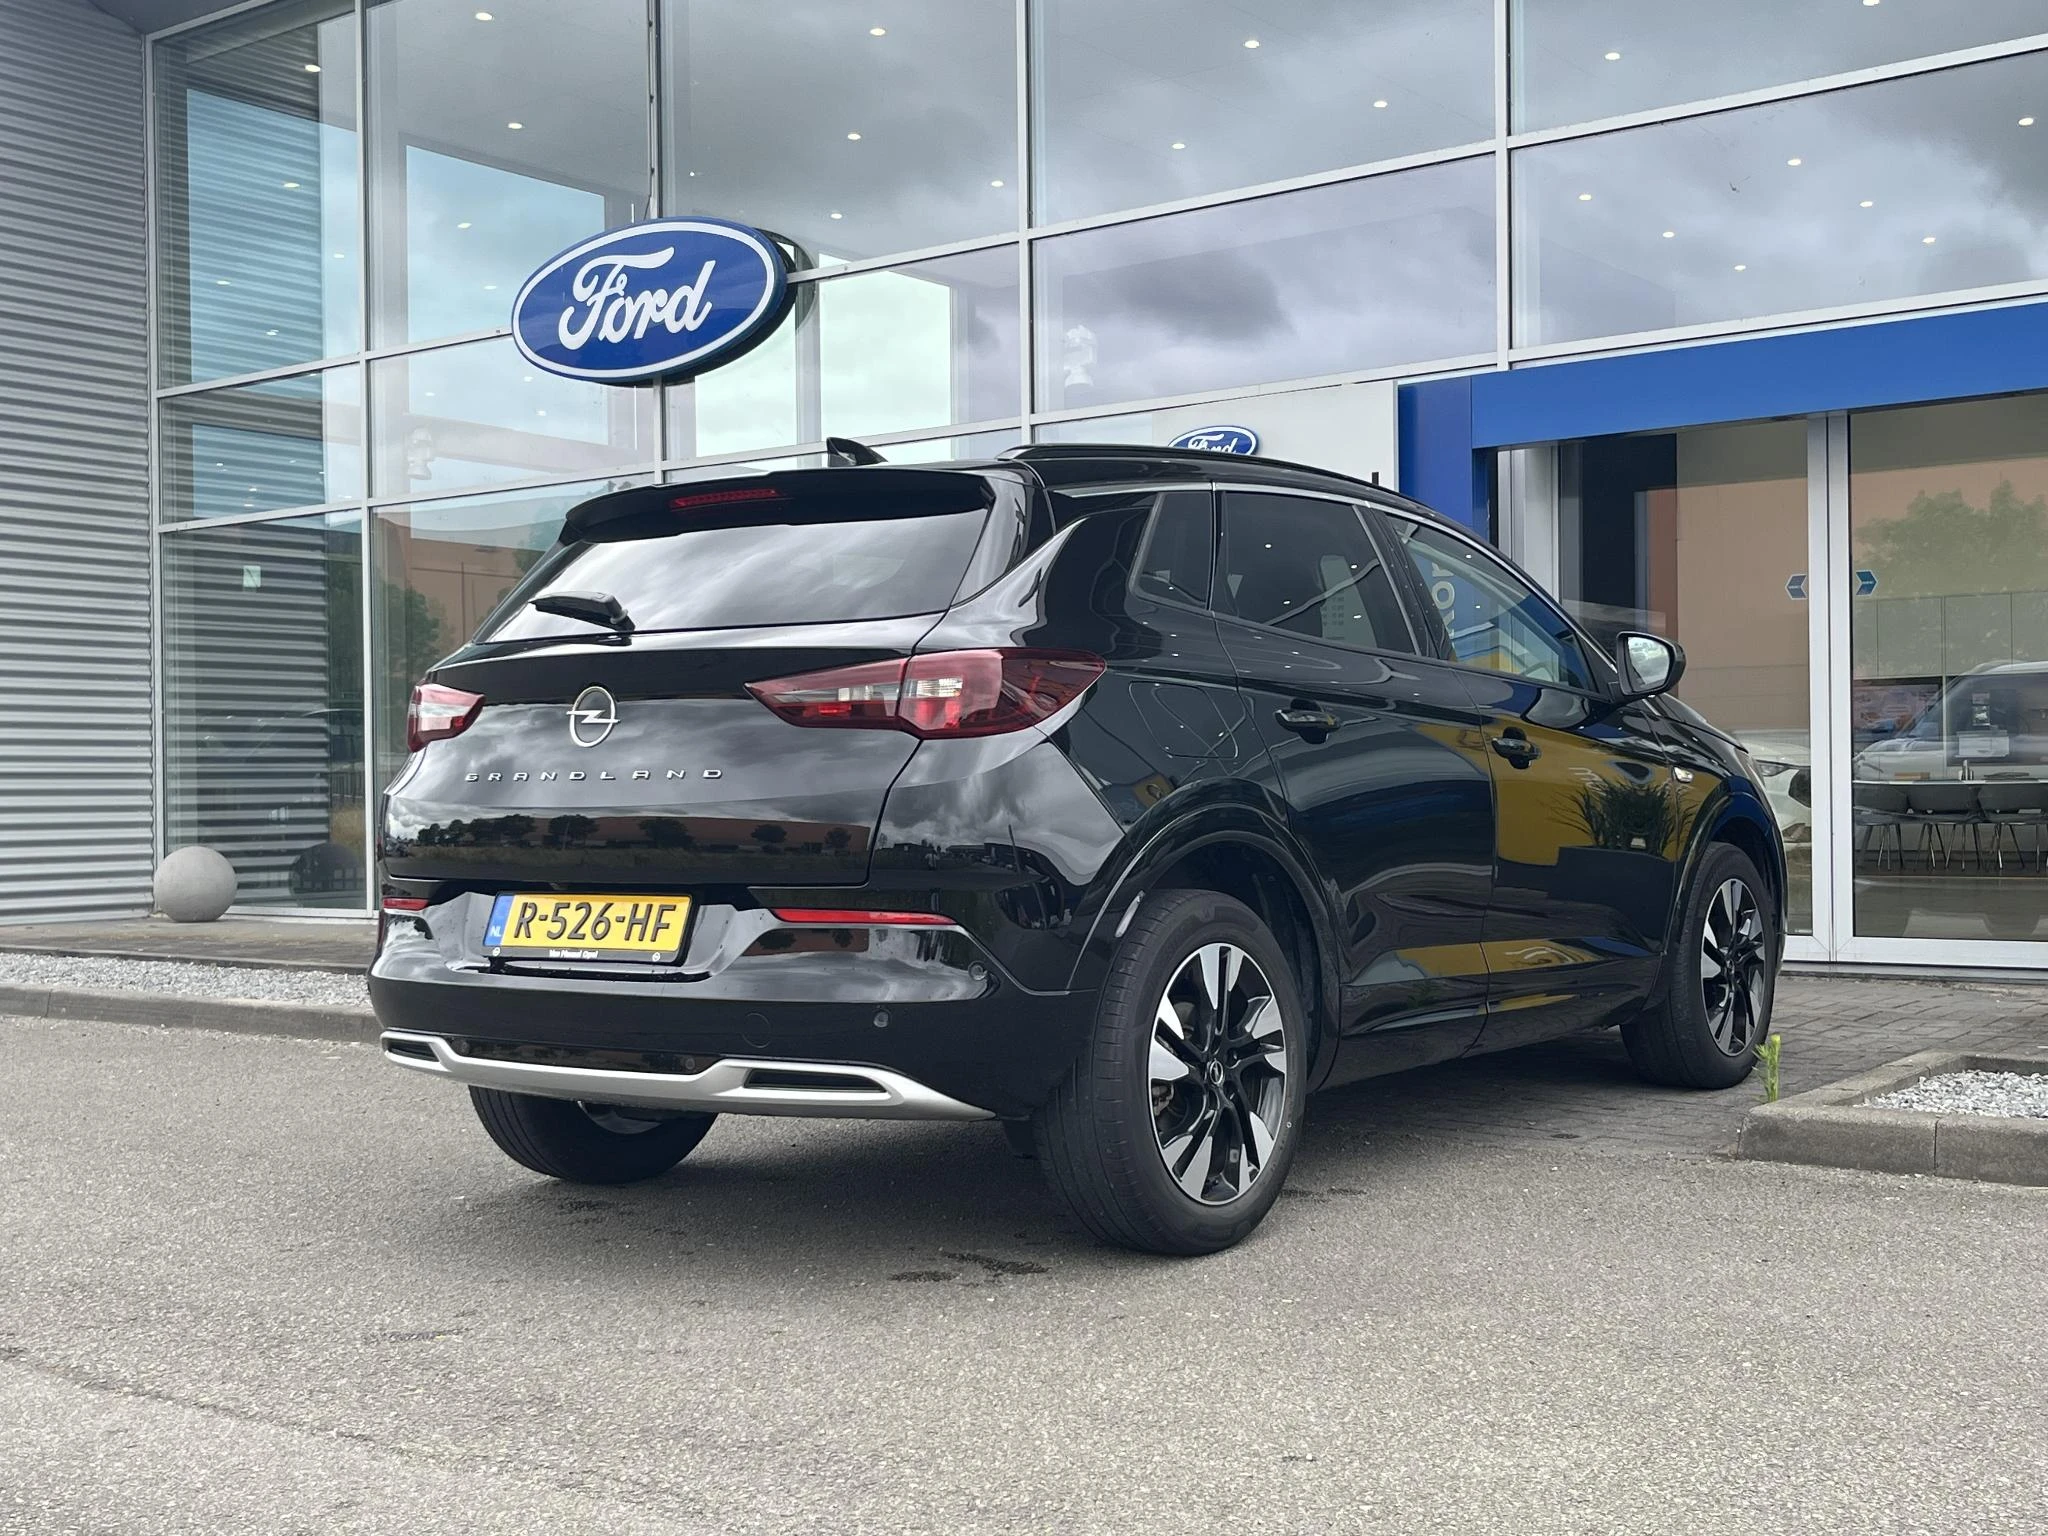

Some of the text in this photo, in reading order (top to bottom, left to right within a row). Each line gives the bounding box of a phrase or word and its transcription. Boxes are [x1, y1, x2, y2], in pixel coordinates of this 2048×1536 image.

[558, 246, 717, 351] Ford
[1187, 432, 1239, 454] Fd
[465, 768, 723, 783] GRANDLAND
[490, 924, 502, 937] NL
[513, 901, 677, 943] R-526-HF
